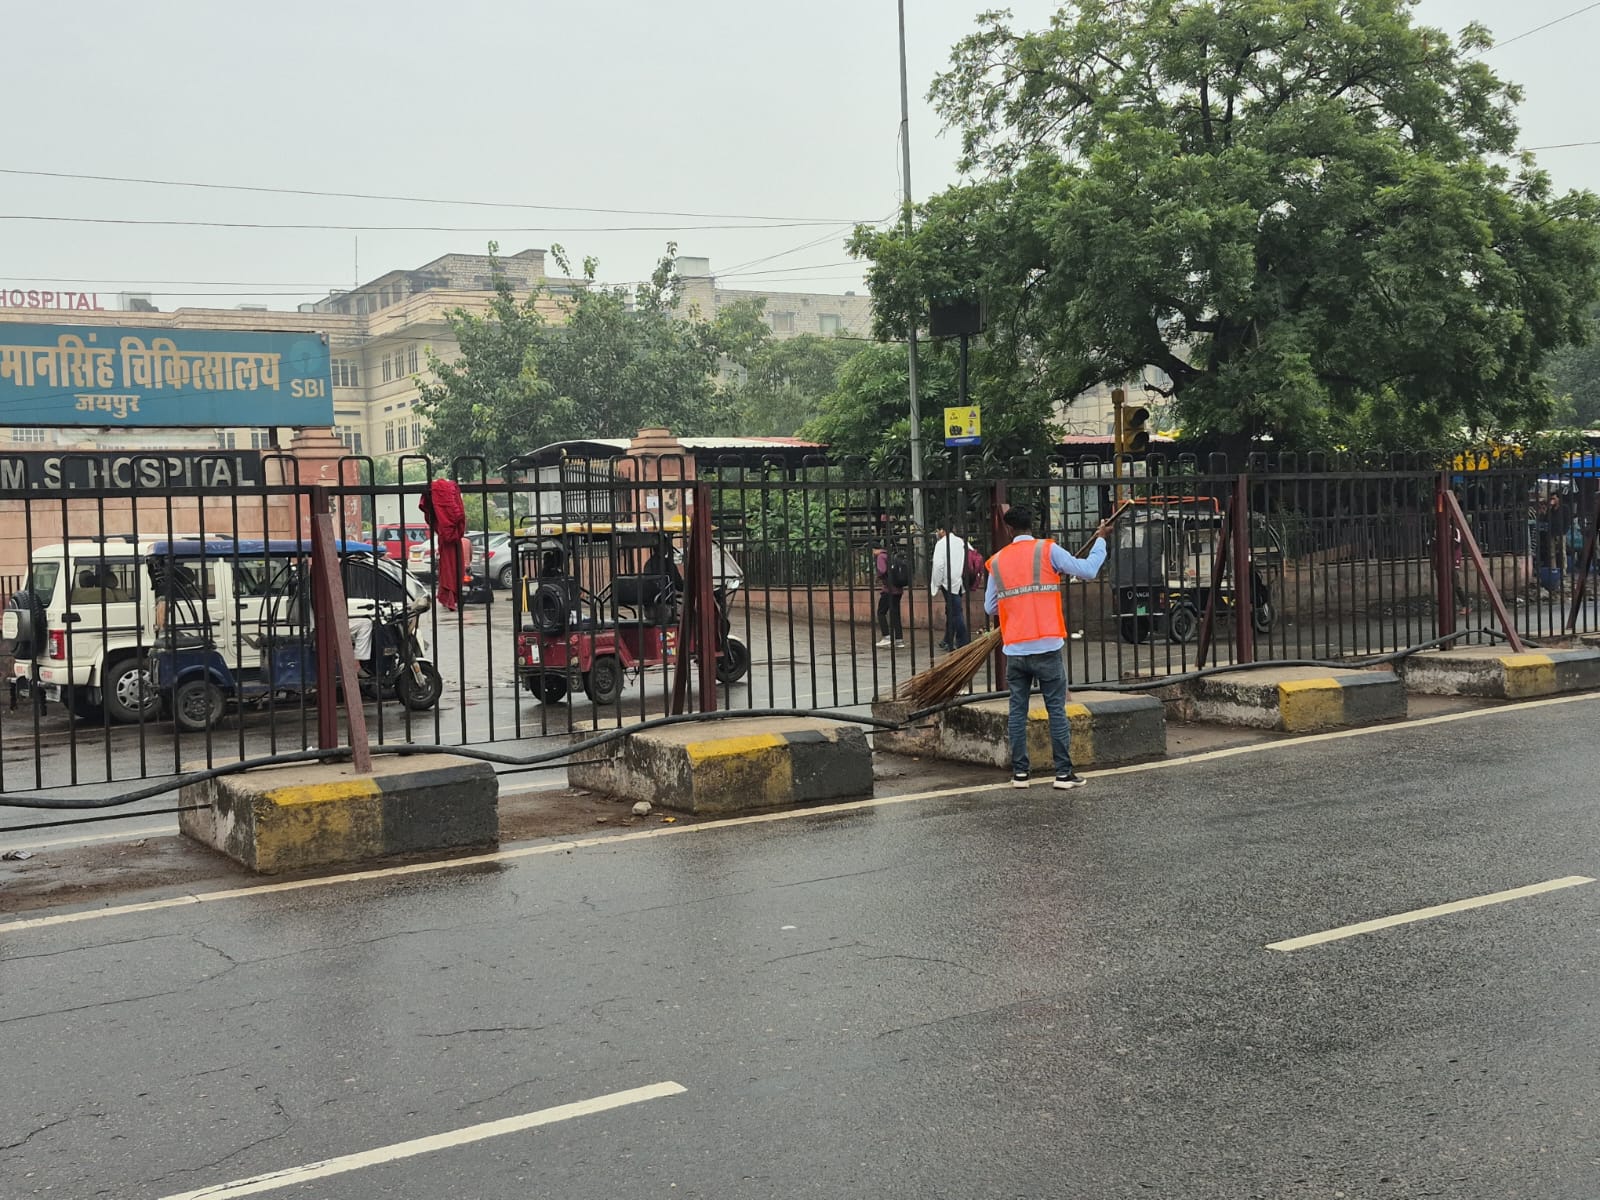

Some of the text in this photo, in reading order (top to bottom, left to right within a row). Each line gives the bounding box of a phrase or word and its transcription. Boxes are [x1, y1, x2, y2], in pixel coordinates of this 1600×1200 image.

[0, 333, 281, 391] मानसिंह चिकित्सालय
[290, 378, 325, 399] SBI
[73, 394, 141, 419] जयपुर
[87, 457, 255, 489] HOSPITAL
[1040, 584, 1058, 592] JAIPUR
